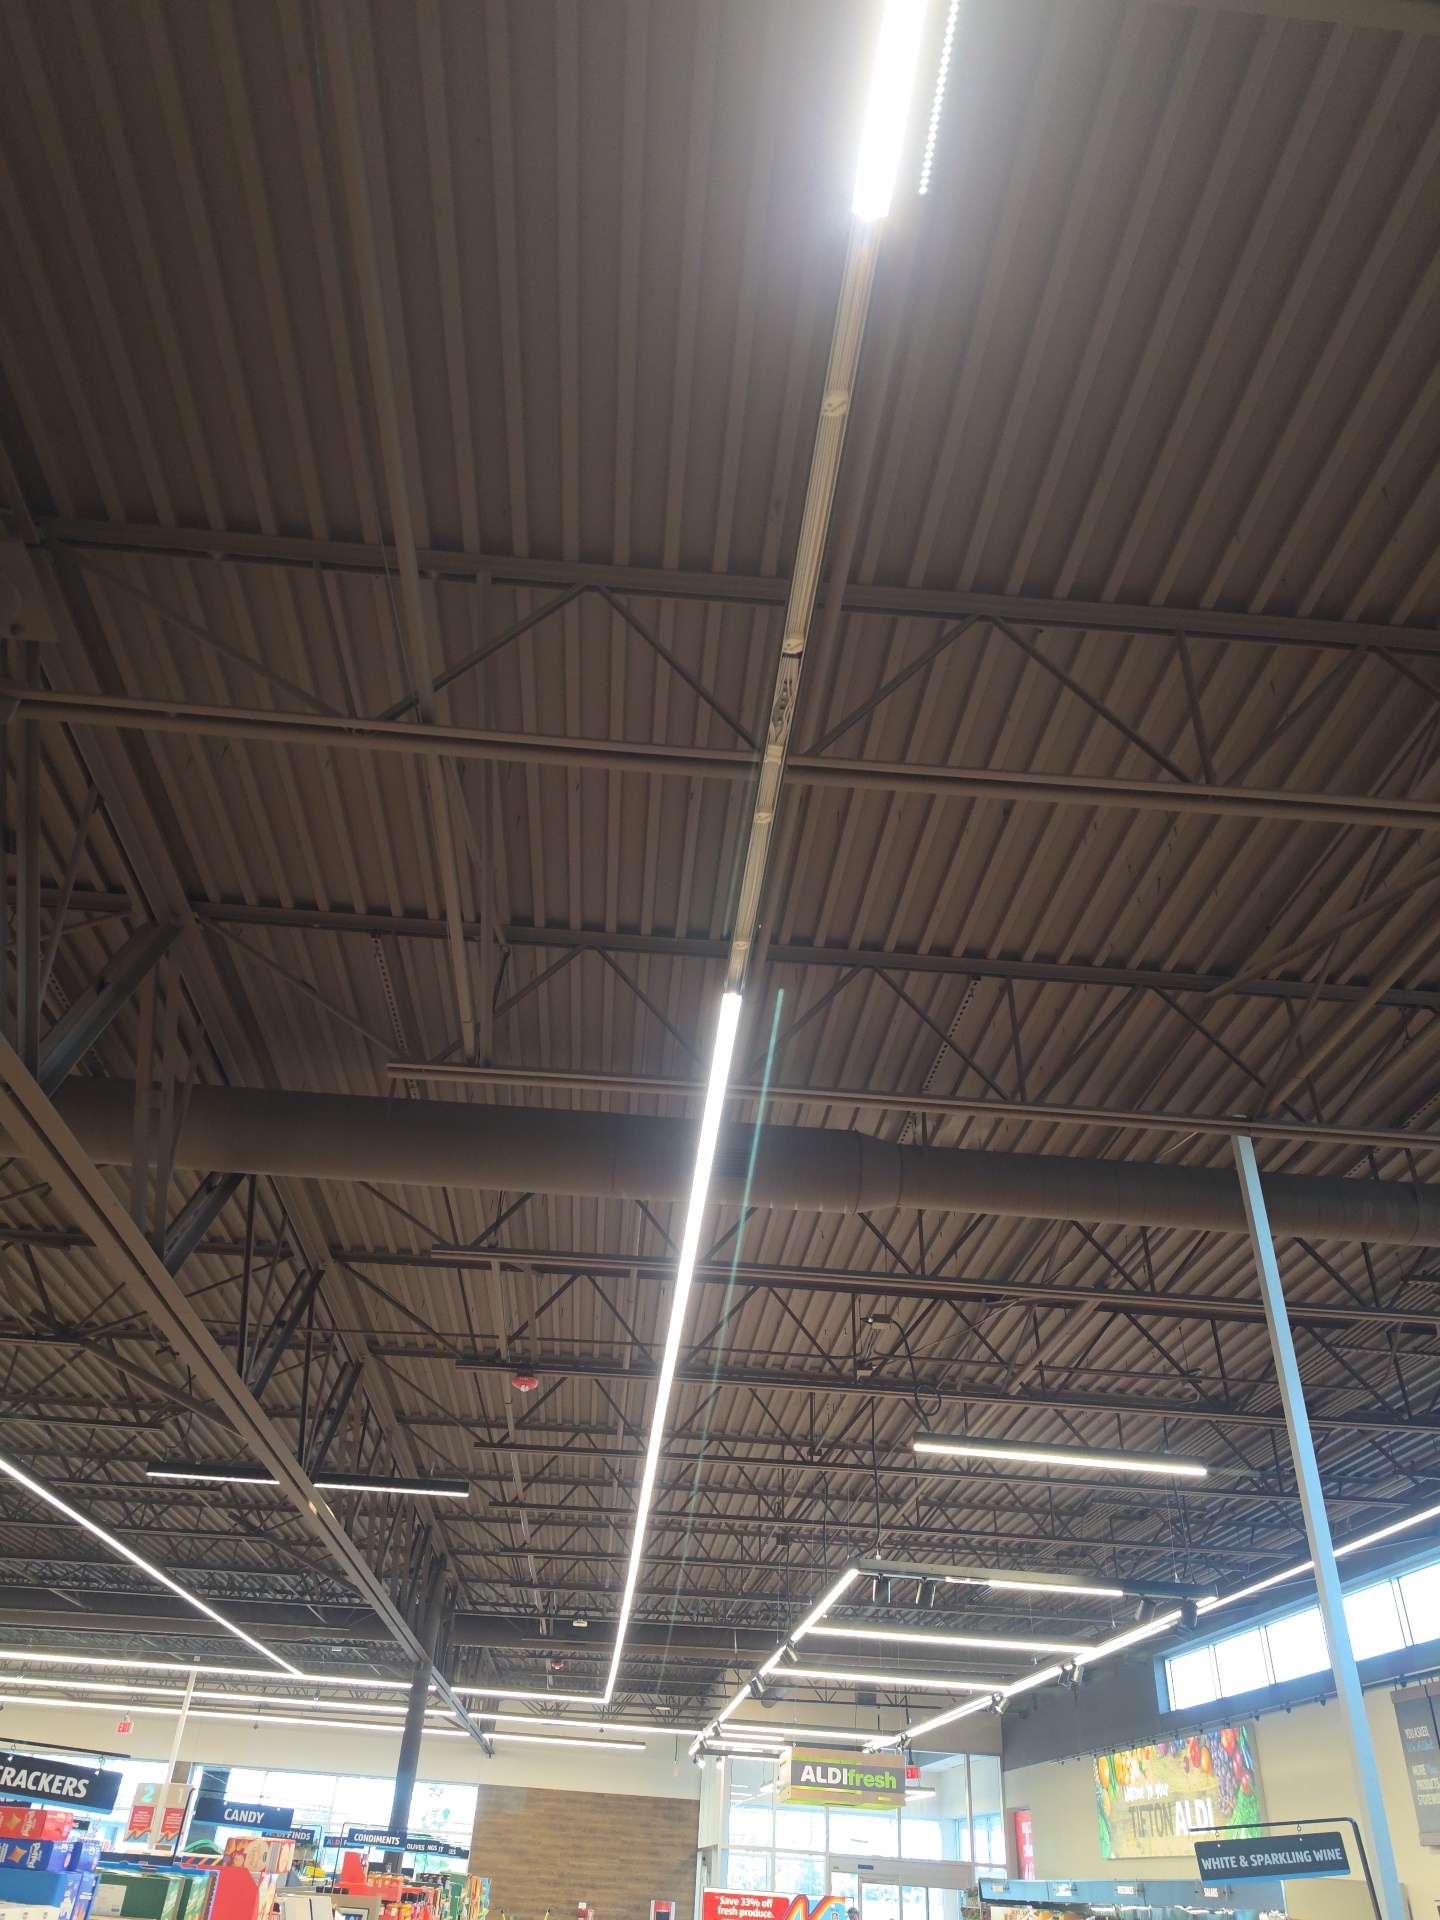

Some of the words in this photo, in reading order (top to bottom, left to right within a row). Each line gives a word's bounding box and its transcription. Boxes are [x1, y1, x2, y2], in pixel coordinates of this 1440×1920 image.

[142, 1785, 155, 1803] 2
[177, 1788, 185, 1804] 1
[224, 1808, 265, 1824] CANDY
[1175, 1798, 1216, 1836] ALDI
[287, 1831, 311, 1840] FINDS
[326, 1838, 341, 1846] ALD
[354, 1833, 400, 1845] CONDIMENTS
[406, 1843, 425, 1851] OLIVES
[27, 1842, 41, 1869] Puffed
[1201, 1856, 1238, 1870] WHITE
[1239, 1855, 1249, 1867] &
[1250, 1850, 1311, 1867] SPARKLING
[1313, 1848, 1343, 1861] WINE
[719, 1896, 739, 1906] Save
[741, 1897, 760, 1907] 33%
[762, 1899, 773, 1908] off
[717, 1905, 738, 1915] fresh
[740, 1907, 774, 1918] produce.
